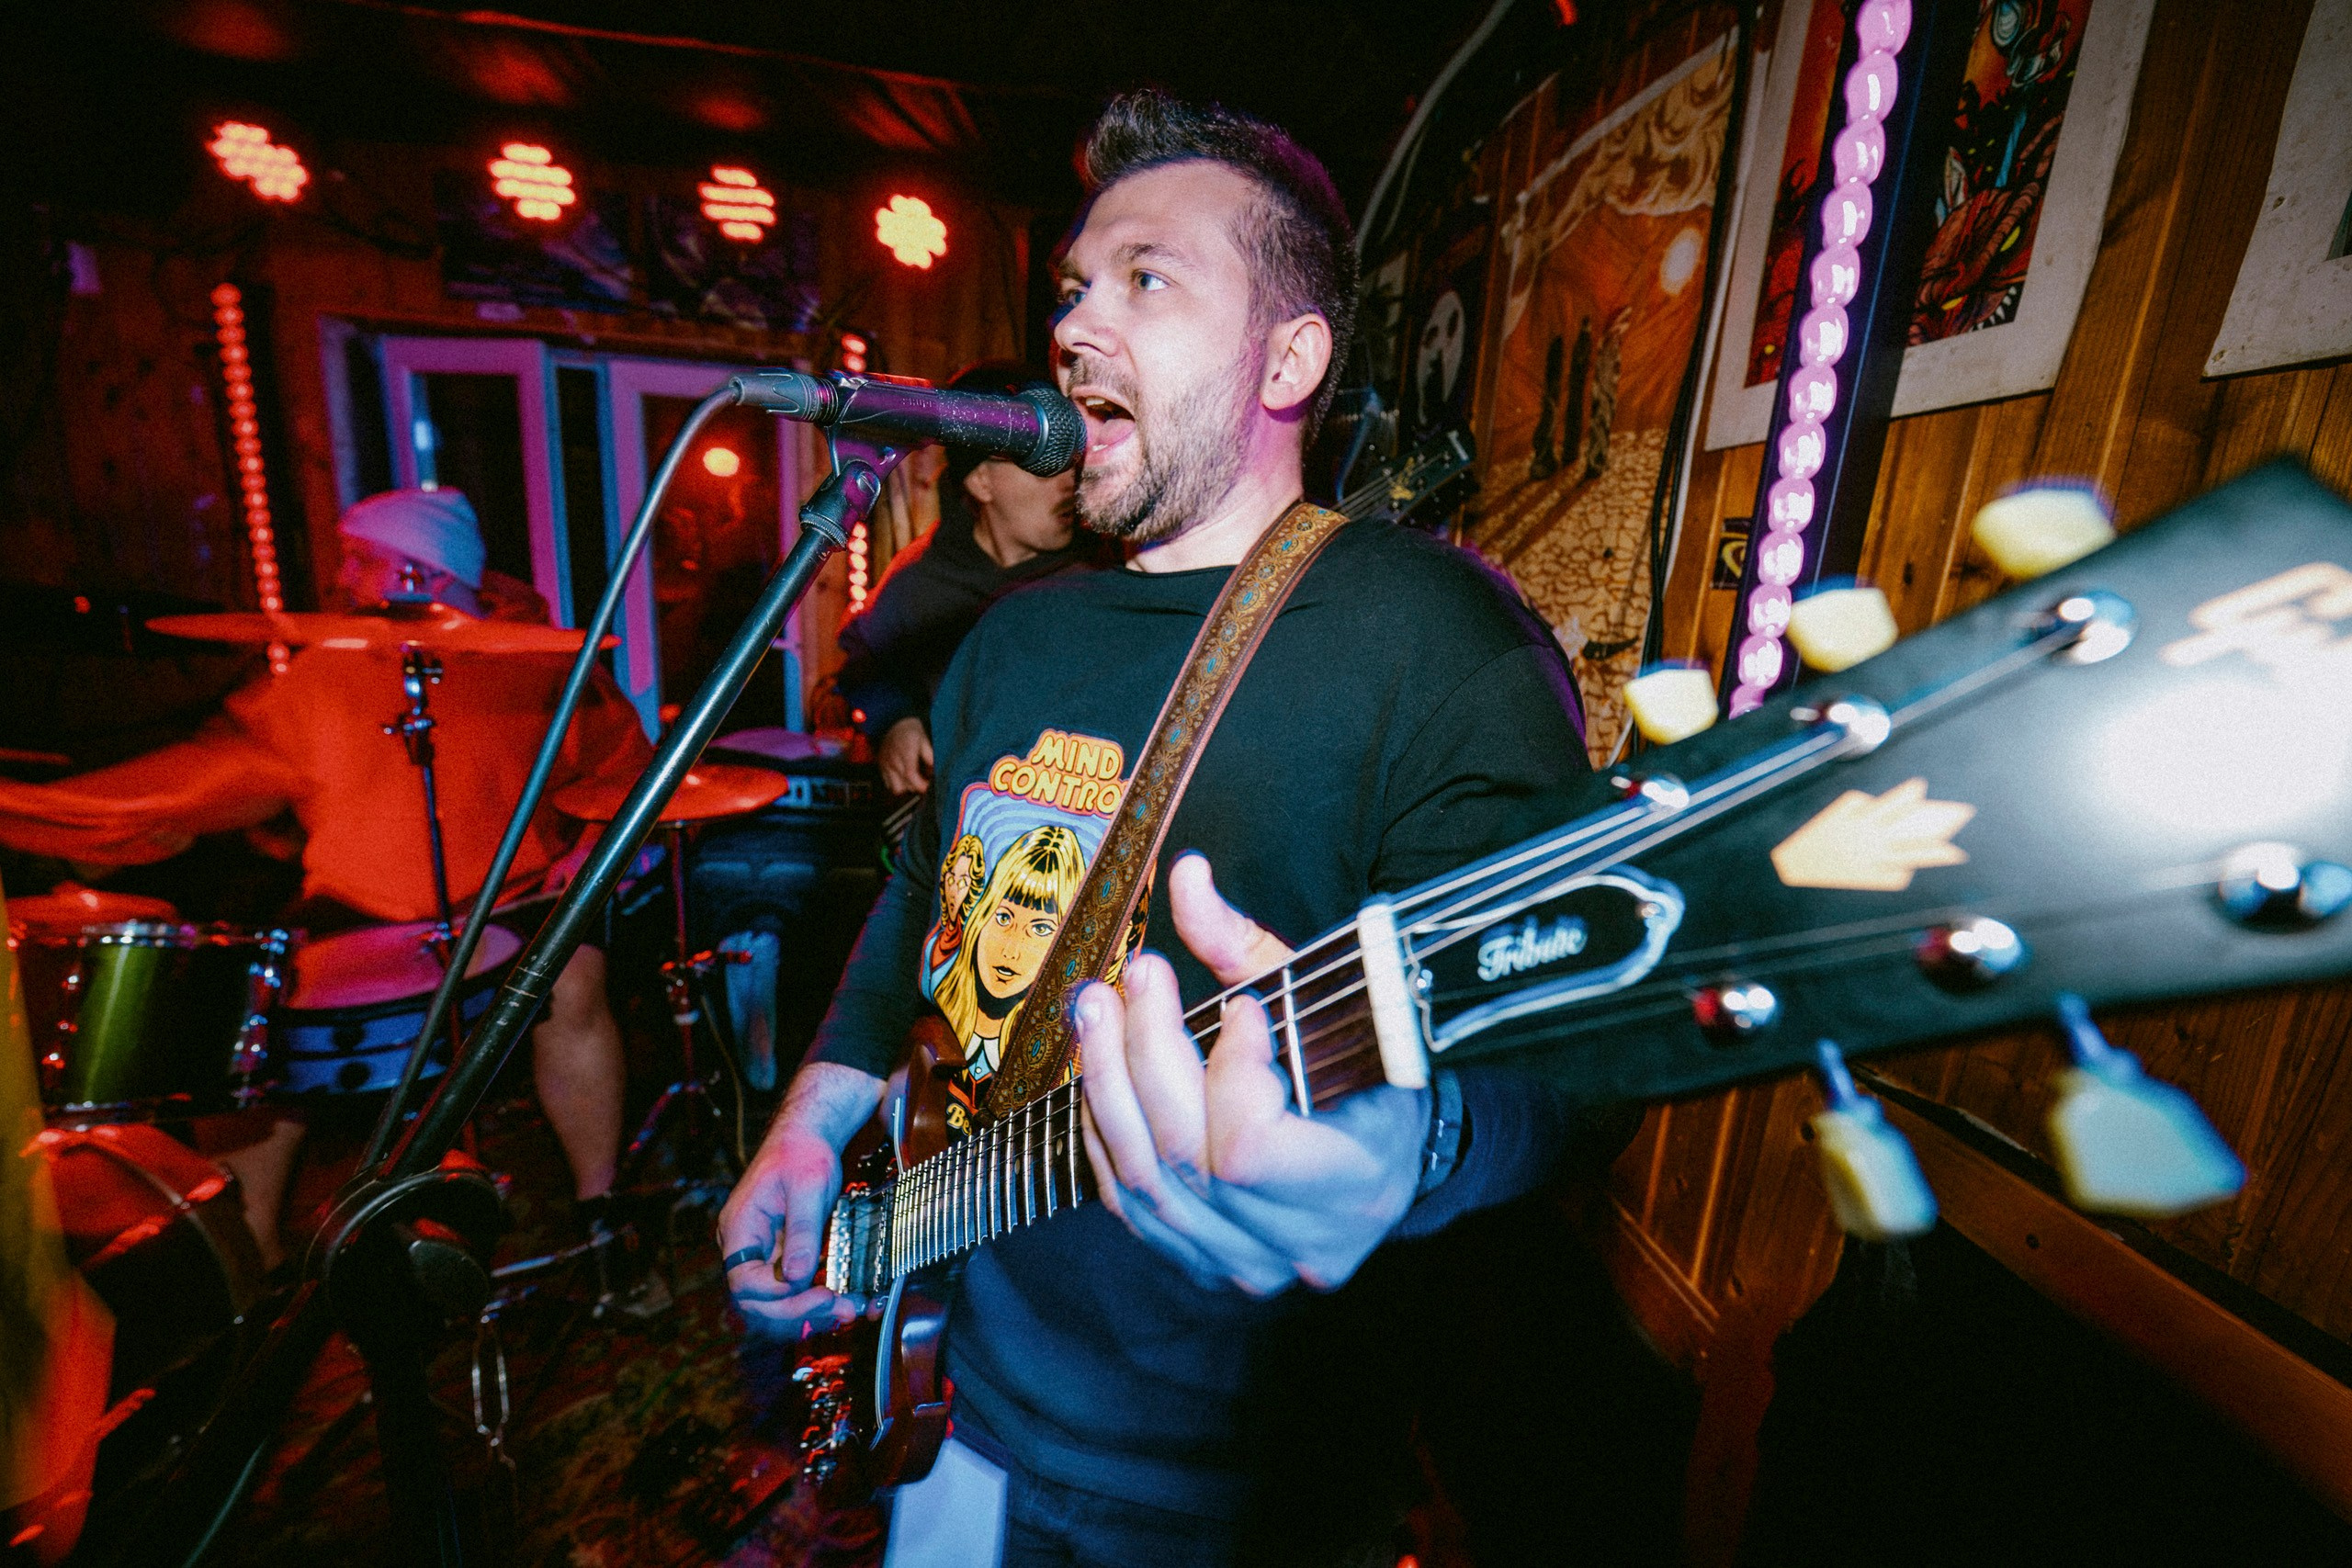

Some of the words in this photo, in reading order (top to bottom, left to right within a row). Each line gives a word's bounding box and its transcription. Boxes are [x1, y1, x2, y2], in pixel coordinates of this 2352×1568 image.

[1031, 734, 1121, 781] MIND
[993, 761, 1125, 815] CONTRO
[946, 1102, 973, 1137] Be
